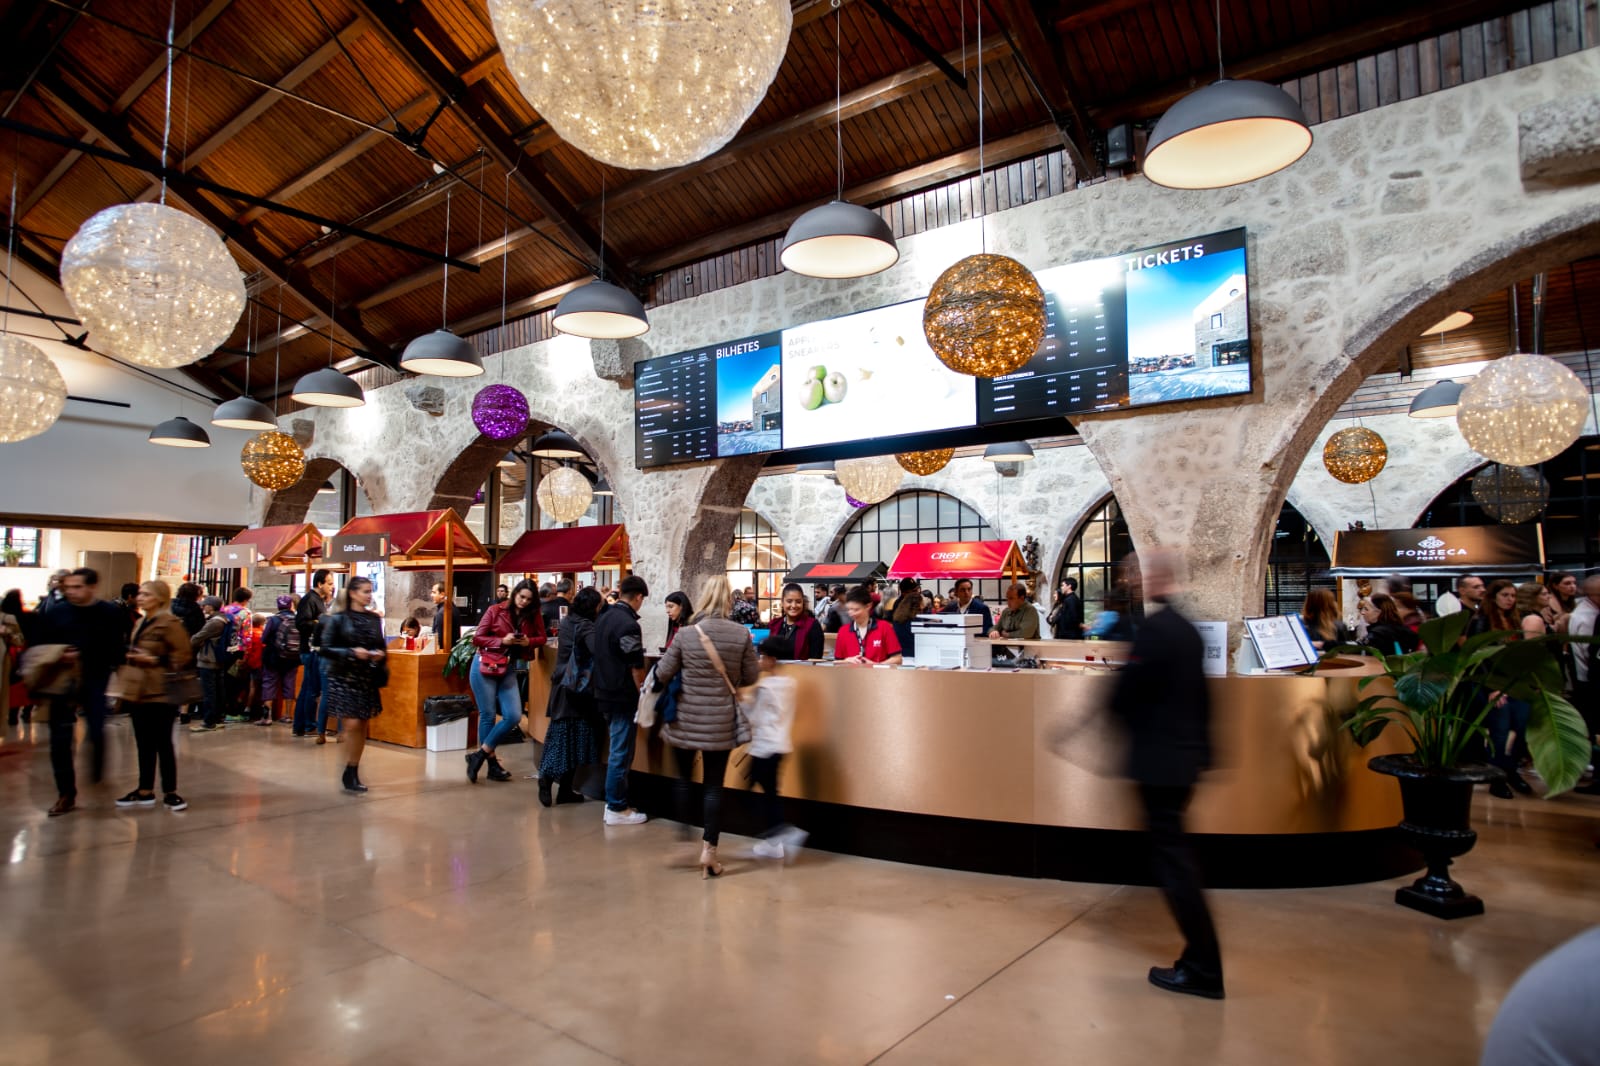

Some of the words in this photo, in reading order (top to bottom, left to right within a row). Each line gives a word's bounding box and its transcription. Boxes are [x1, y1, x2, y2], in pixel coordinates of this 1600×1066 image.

[1126, 244, 1204, 272] TICKETS
[788, 336, 816, 347] APPL
[716, 340, 760, 359] BILHETES
[787, 341, 840, 359] SNEAERS
[931, 551, 971, 560] CROFT
[1396, 548, 1467, 557] FONSECA
